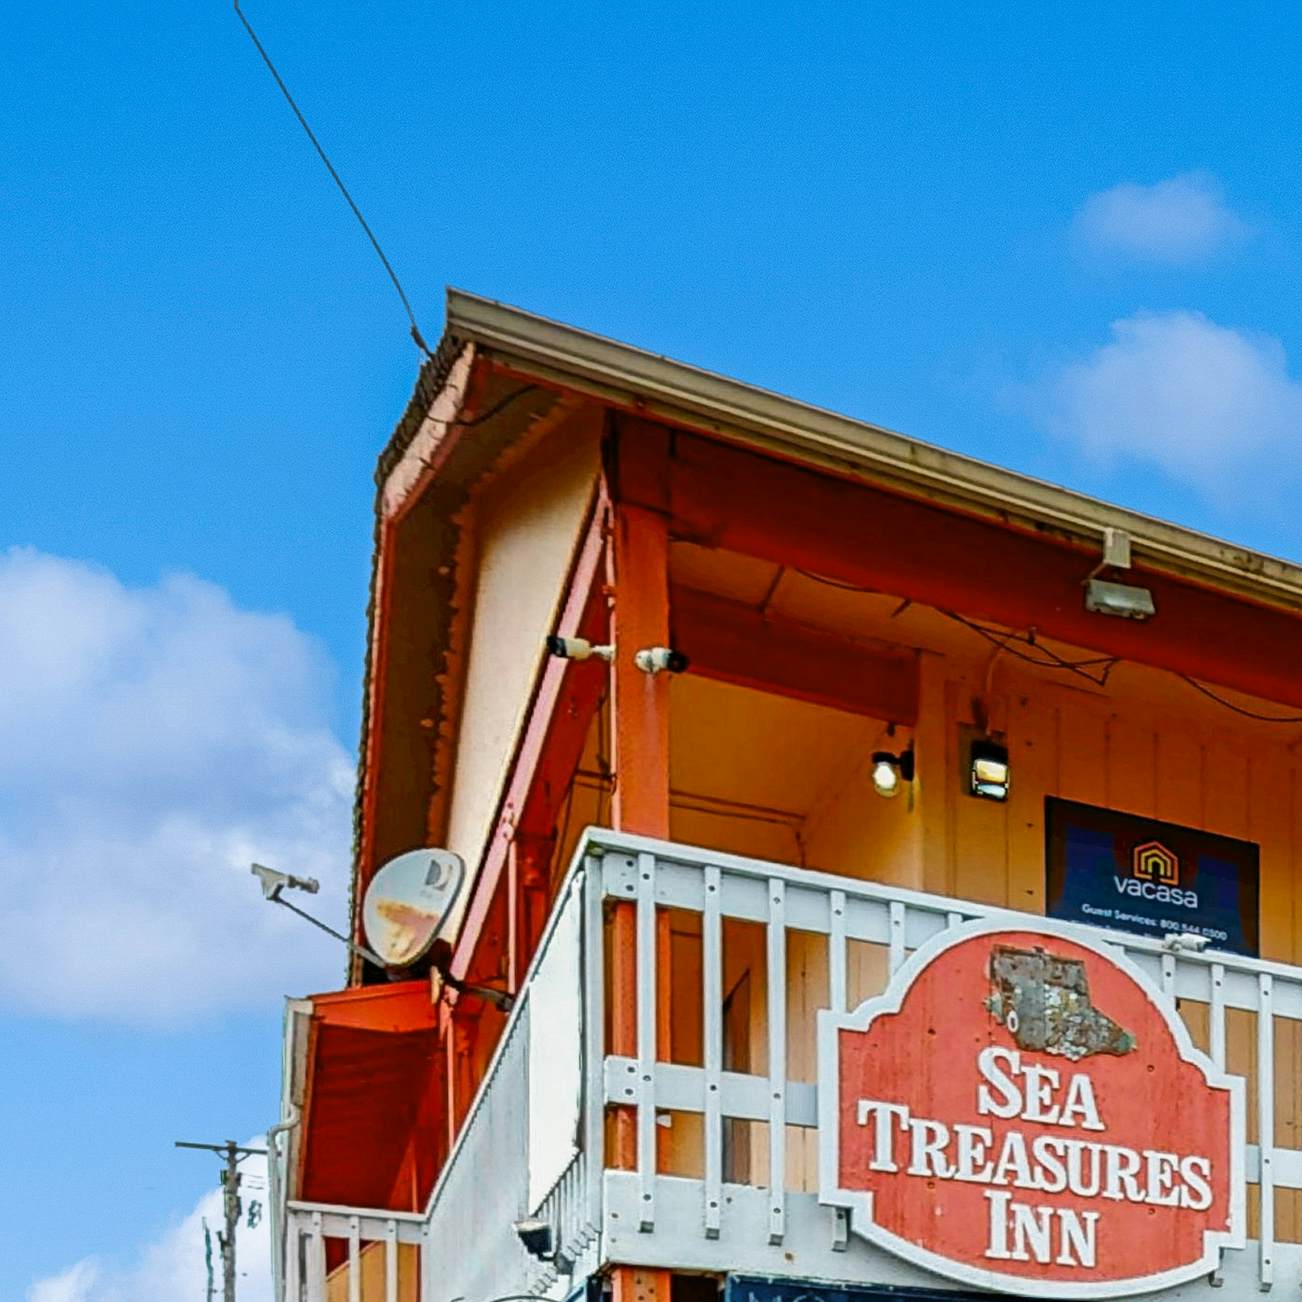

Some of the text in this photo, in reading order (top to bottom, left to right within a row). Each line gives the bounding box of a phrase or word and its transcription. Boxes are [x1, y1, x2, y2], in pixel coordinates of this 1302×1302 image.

[1081, 903, 1112, 917] Guest
[1114, 875, 1199, 909] vacasa
[976, 1047, 1106, 1131] SEA
[857, 1099, 1213, 1211] TREASURES
[983, 1189, 1100, 1268] INN
